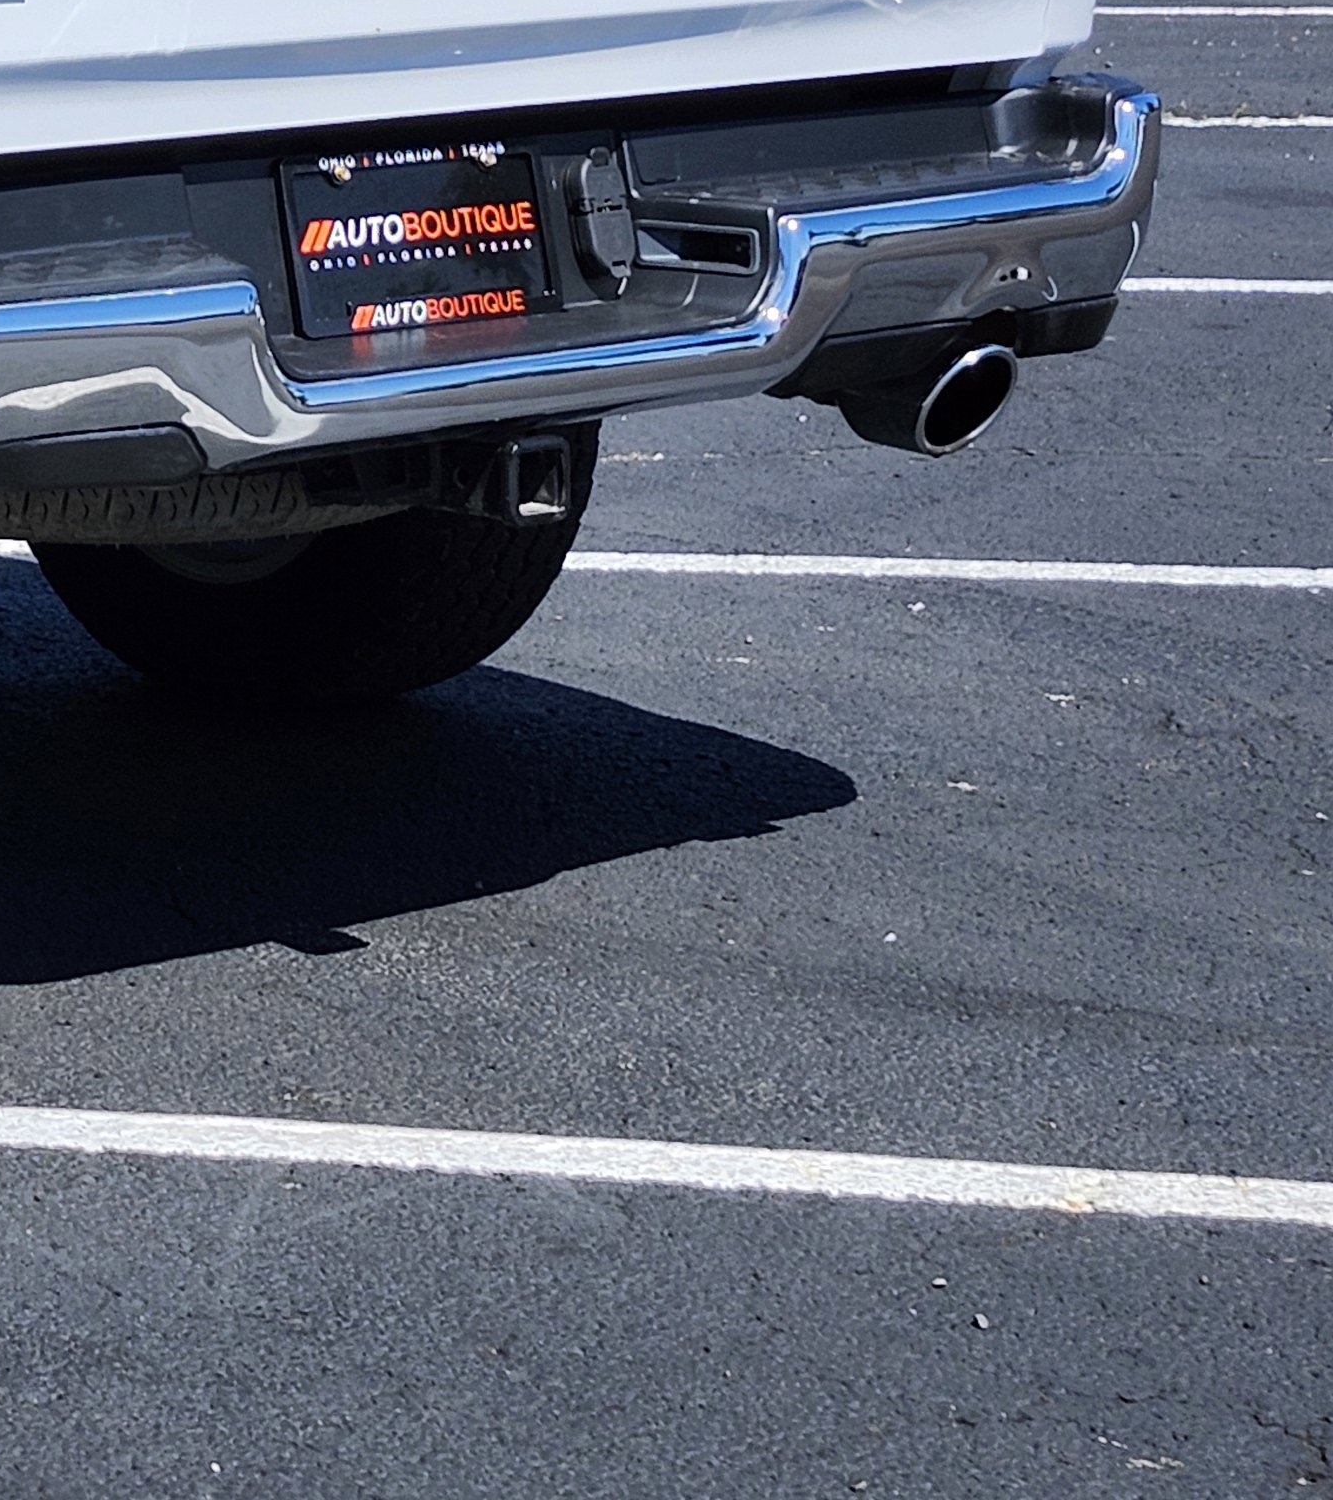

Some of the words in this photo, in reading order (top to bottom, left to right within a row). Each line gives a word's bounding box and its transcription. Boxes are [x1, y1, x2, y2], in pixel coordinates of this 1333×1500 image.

[375, 148, 443, 165] FLORIDA
[309, 257, 356, 271] OHIO
[377, 246, 456, 264] FLORIDA
[479, 238, 532, 252] TEXAS
